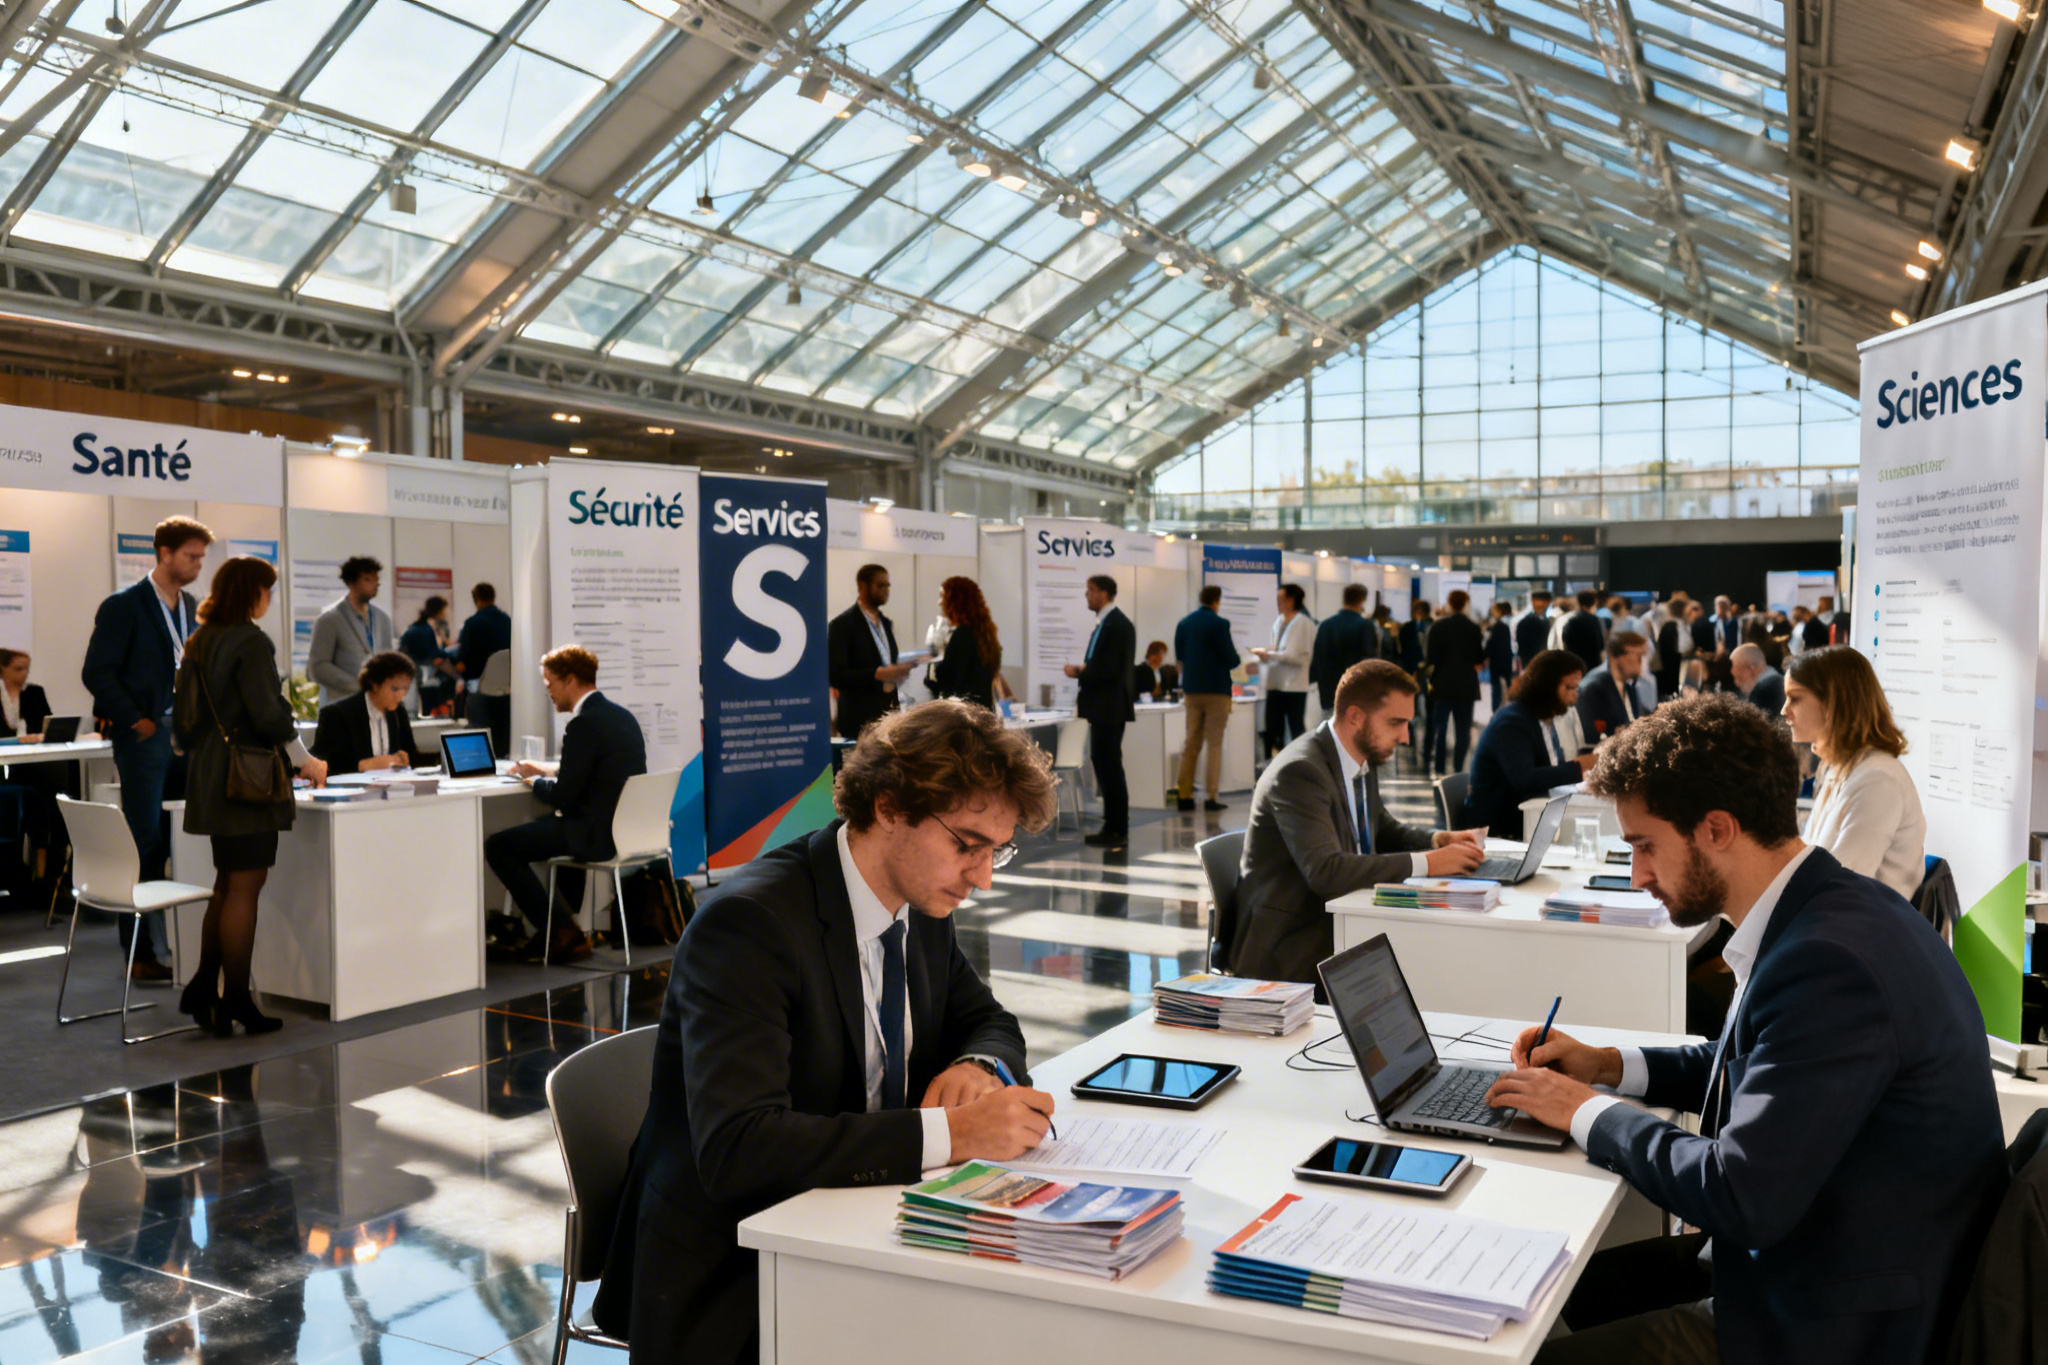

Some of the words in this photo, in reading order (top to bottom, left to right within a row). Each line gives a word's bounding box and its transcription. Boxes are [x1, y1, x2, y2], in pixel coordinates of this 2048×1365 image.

[1877, 358, 2022, 429] Sciences
[72, 432, 191, 481] Santé
[568, 487, 684, 529] Sécurité
[723, 543, 810, 680] S
